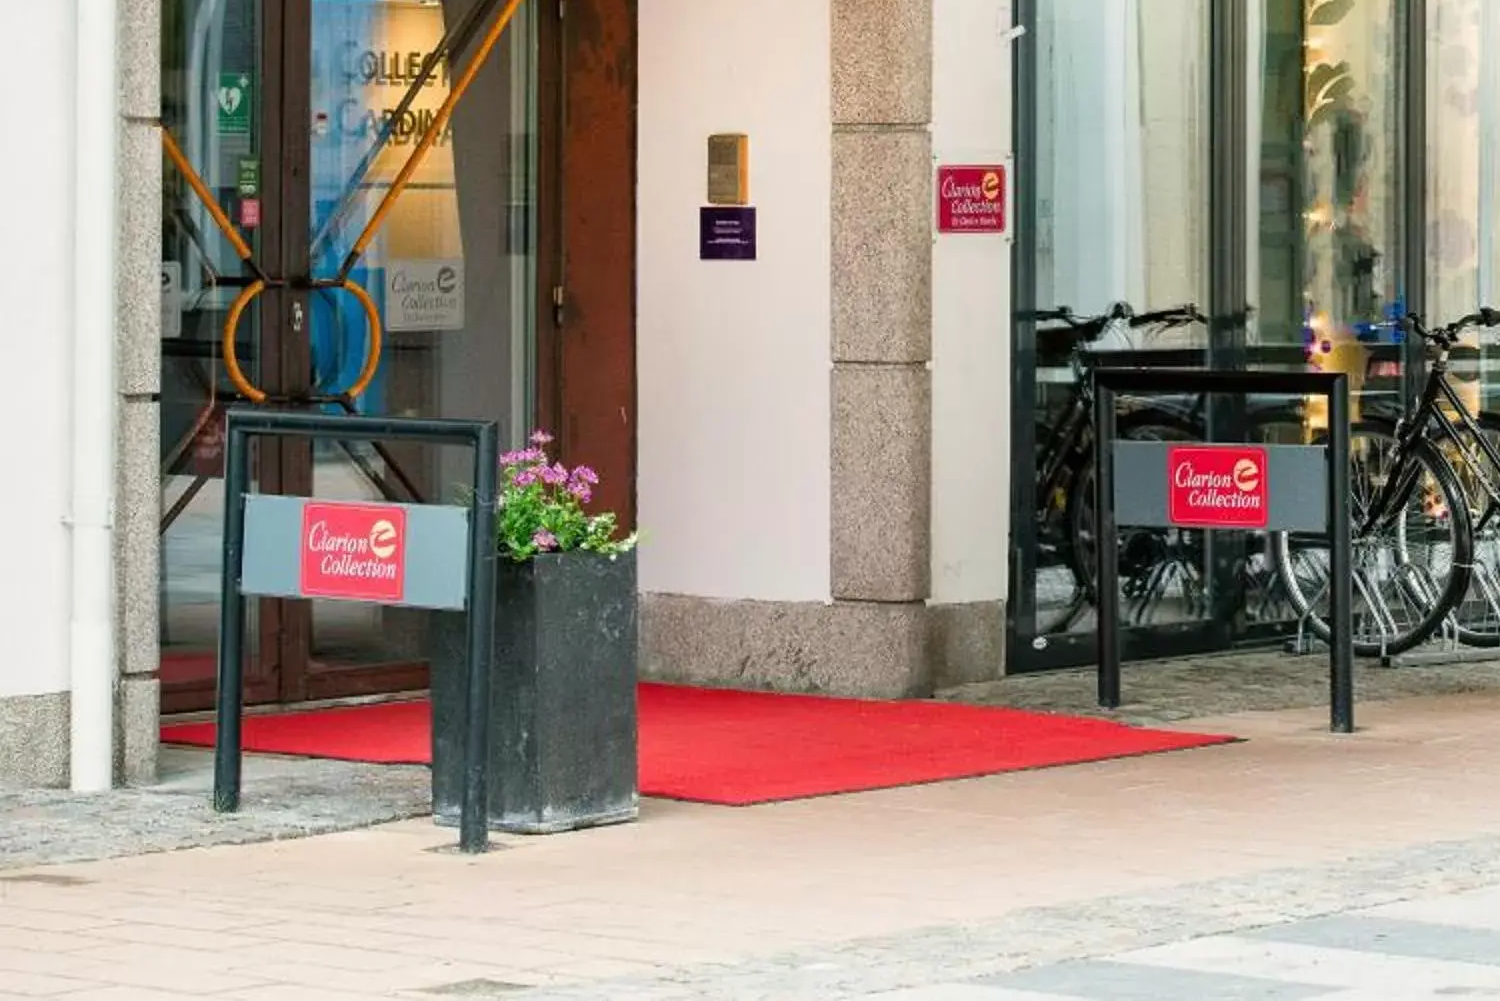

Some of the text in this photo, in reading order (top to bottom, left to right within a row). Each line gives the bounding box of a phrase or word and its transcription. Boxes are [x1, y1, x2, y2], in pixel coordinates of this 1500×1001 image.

[942, 175, 981, 199] Clarion
[1175, 460, 1232, 488] Clarion
[1188, 489, 1260, 508] Collection
[308, 520, 369, 553] Clarion
[320, 554, 396, 578] Collection
